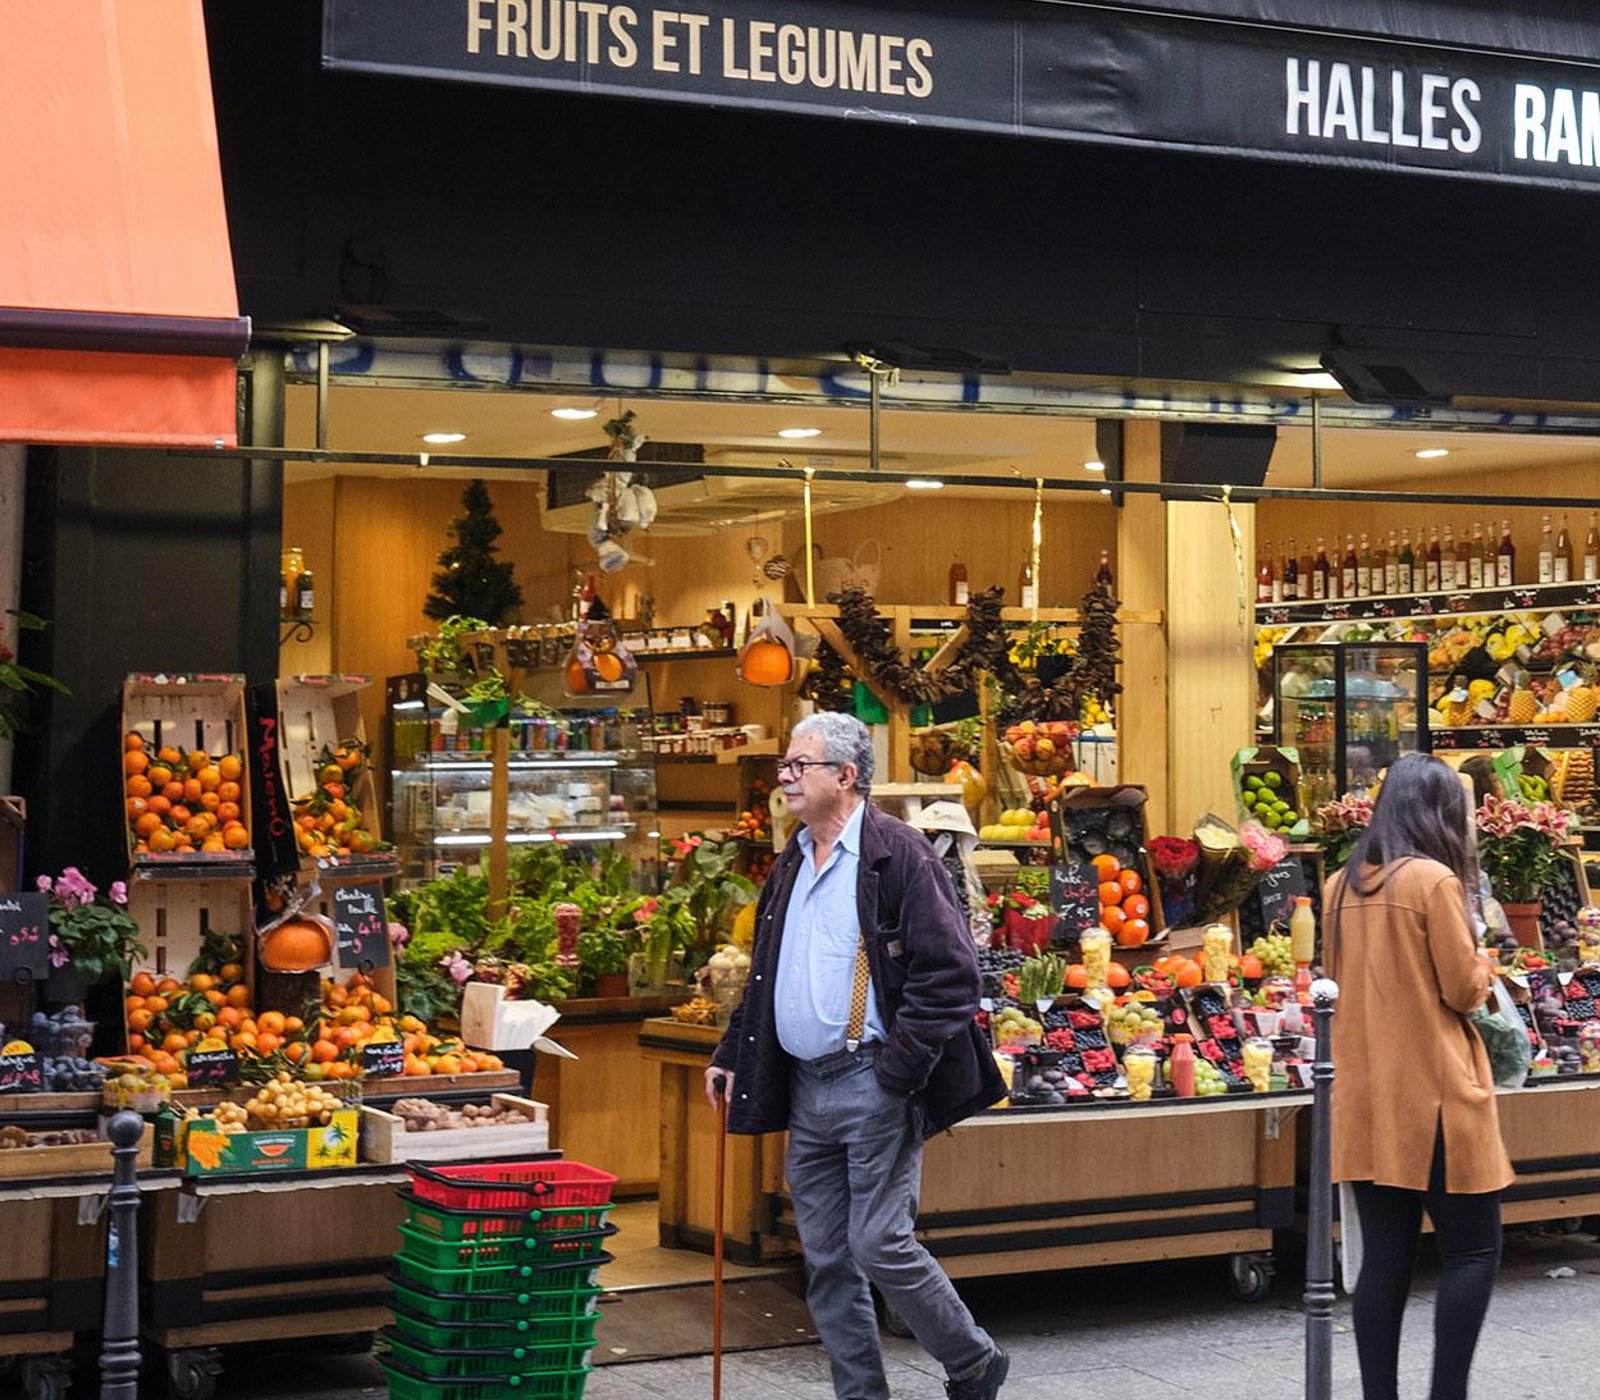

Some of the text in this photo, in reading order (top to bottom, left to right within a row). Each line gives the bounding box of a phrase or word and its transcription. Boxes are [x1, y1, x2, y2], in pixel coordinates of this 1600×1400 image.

[467, 0, 934, 98] FRUITS ET LEGUMES
[1286, 57, 1481, 153] HALLES
